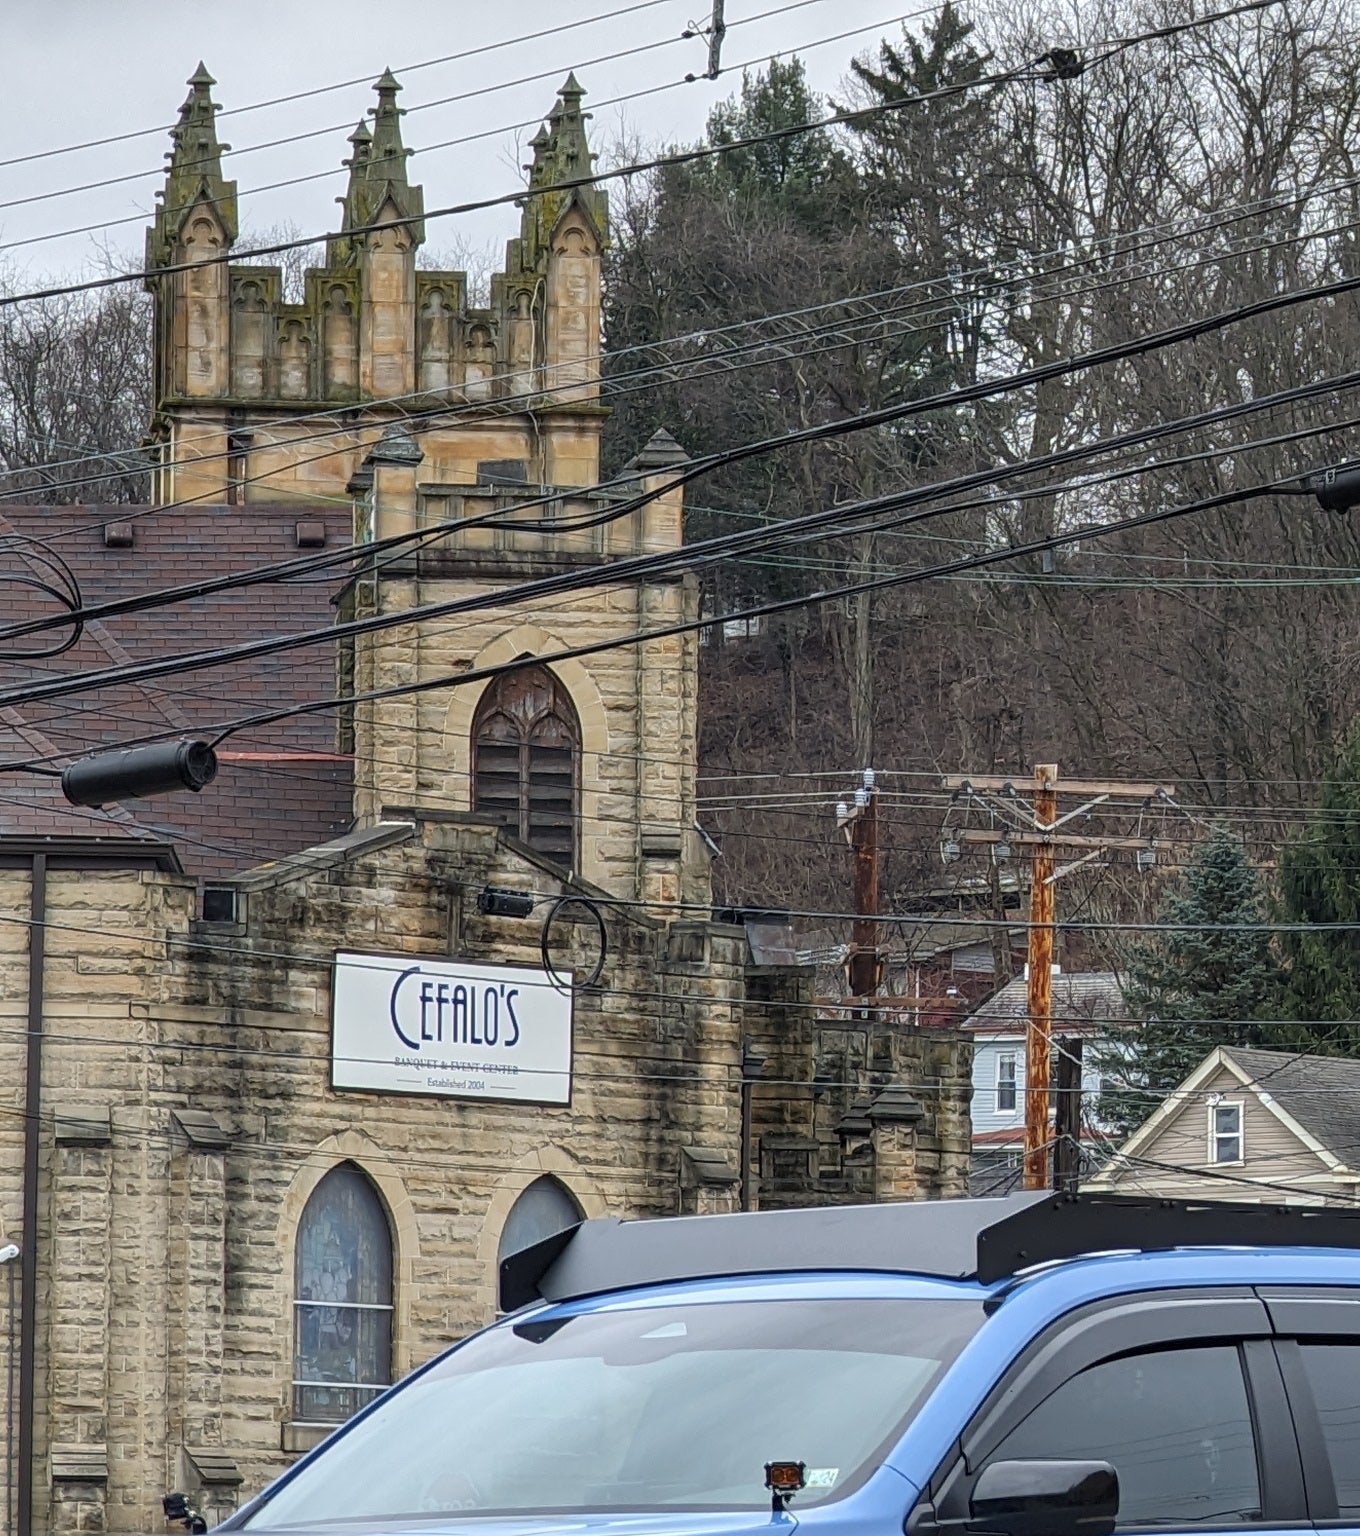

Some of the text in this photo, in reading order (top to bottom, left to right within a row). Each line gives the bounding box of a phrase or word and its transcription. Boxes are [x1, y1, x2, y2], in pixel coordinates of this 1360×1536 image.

[390, 965, 520, 1051] CEFALO'S
[395, 1056, 438, 1071] BANQUET
[440, 1060, 448, 1070] &
[450, 1060, 481, 1073] EVENT
[427, 1077, 467, 1089] Established
